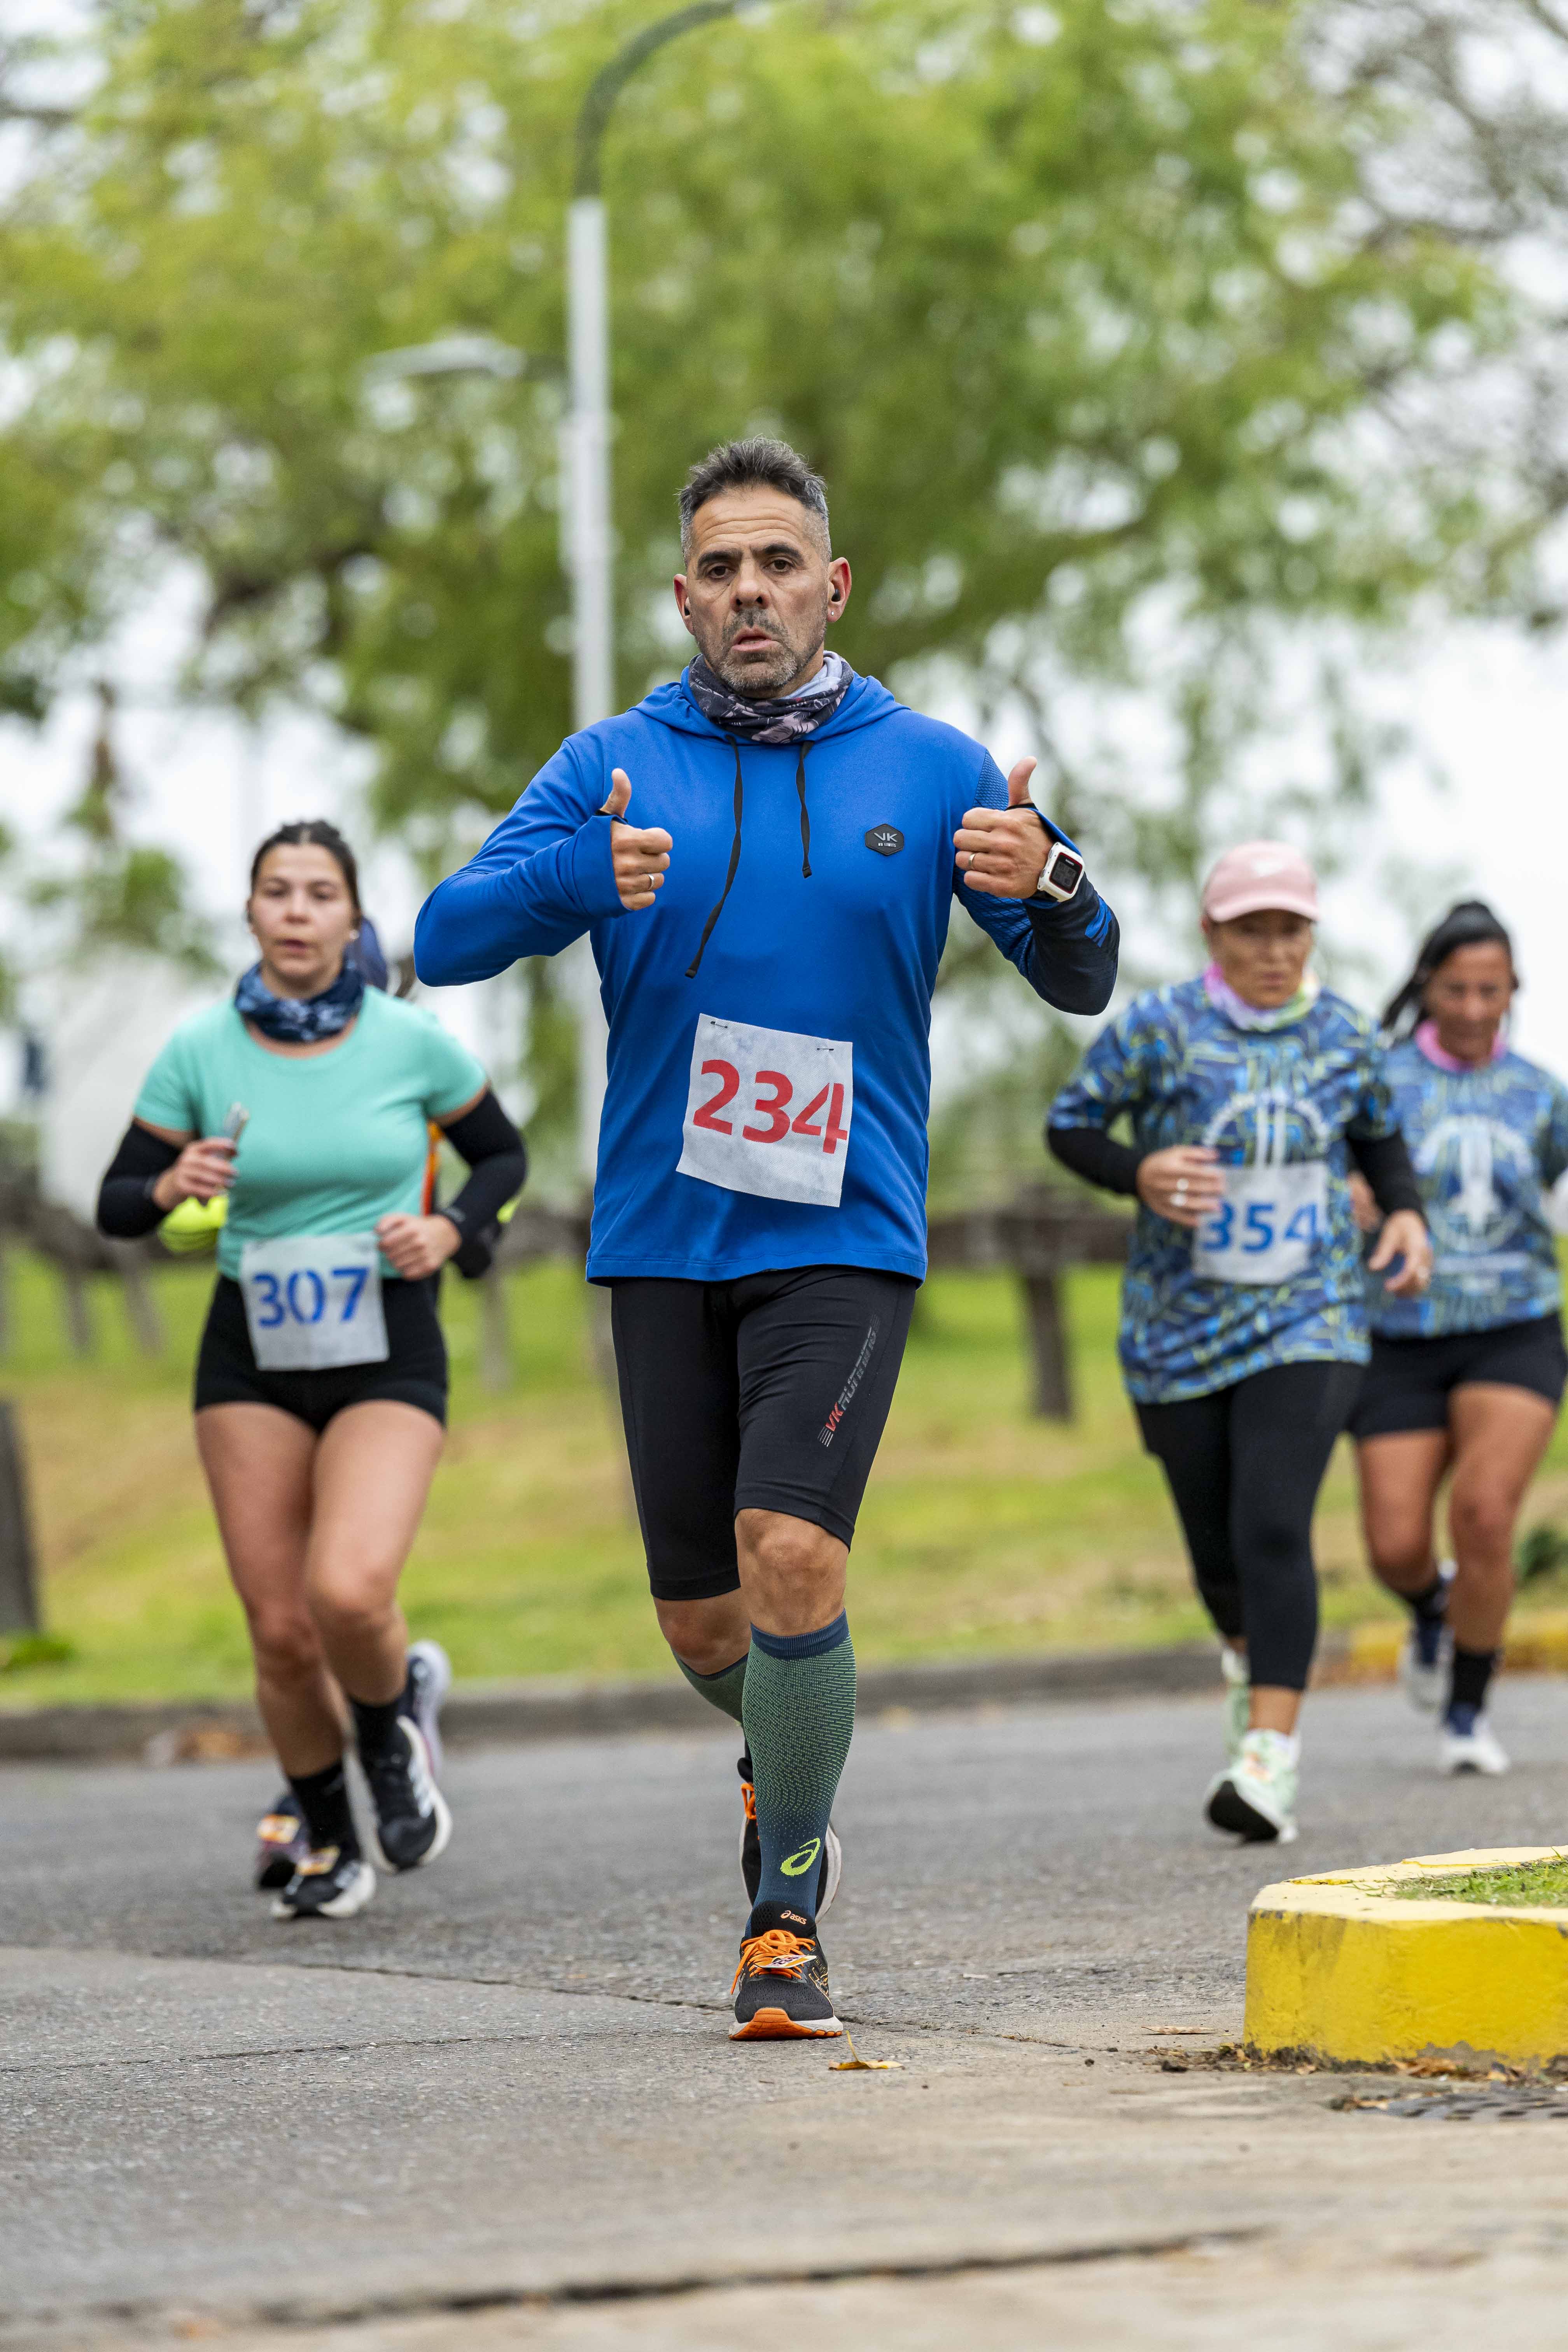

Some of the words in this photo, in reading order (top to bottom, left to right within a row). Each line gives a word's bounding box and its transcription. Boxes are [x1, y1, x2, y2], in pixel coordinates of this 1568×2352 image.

[874, 833, 898, 842] VK
[693, 1059, 848, 1154] 234
[1201, 1200, 1320, 1253] 354
[252, 1265, 371, 1330] 307
[790, 1914, 807, 1925] asics
